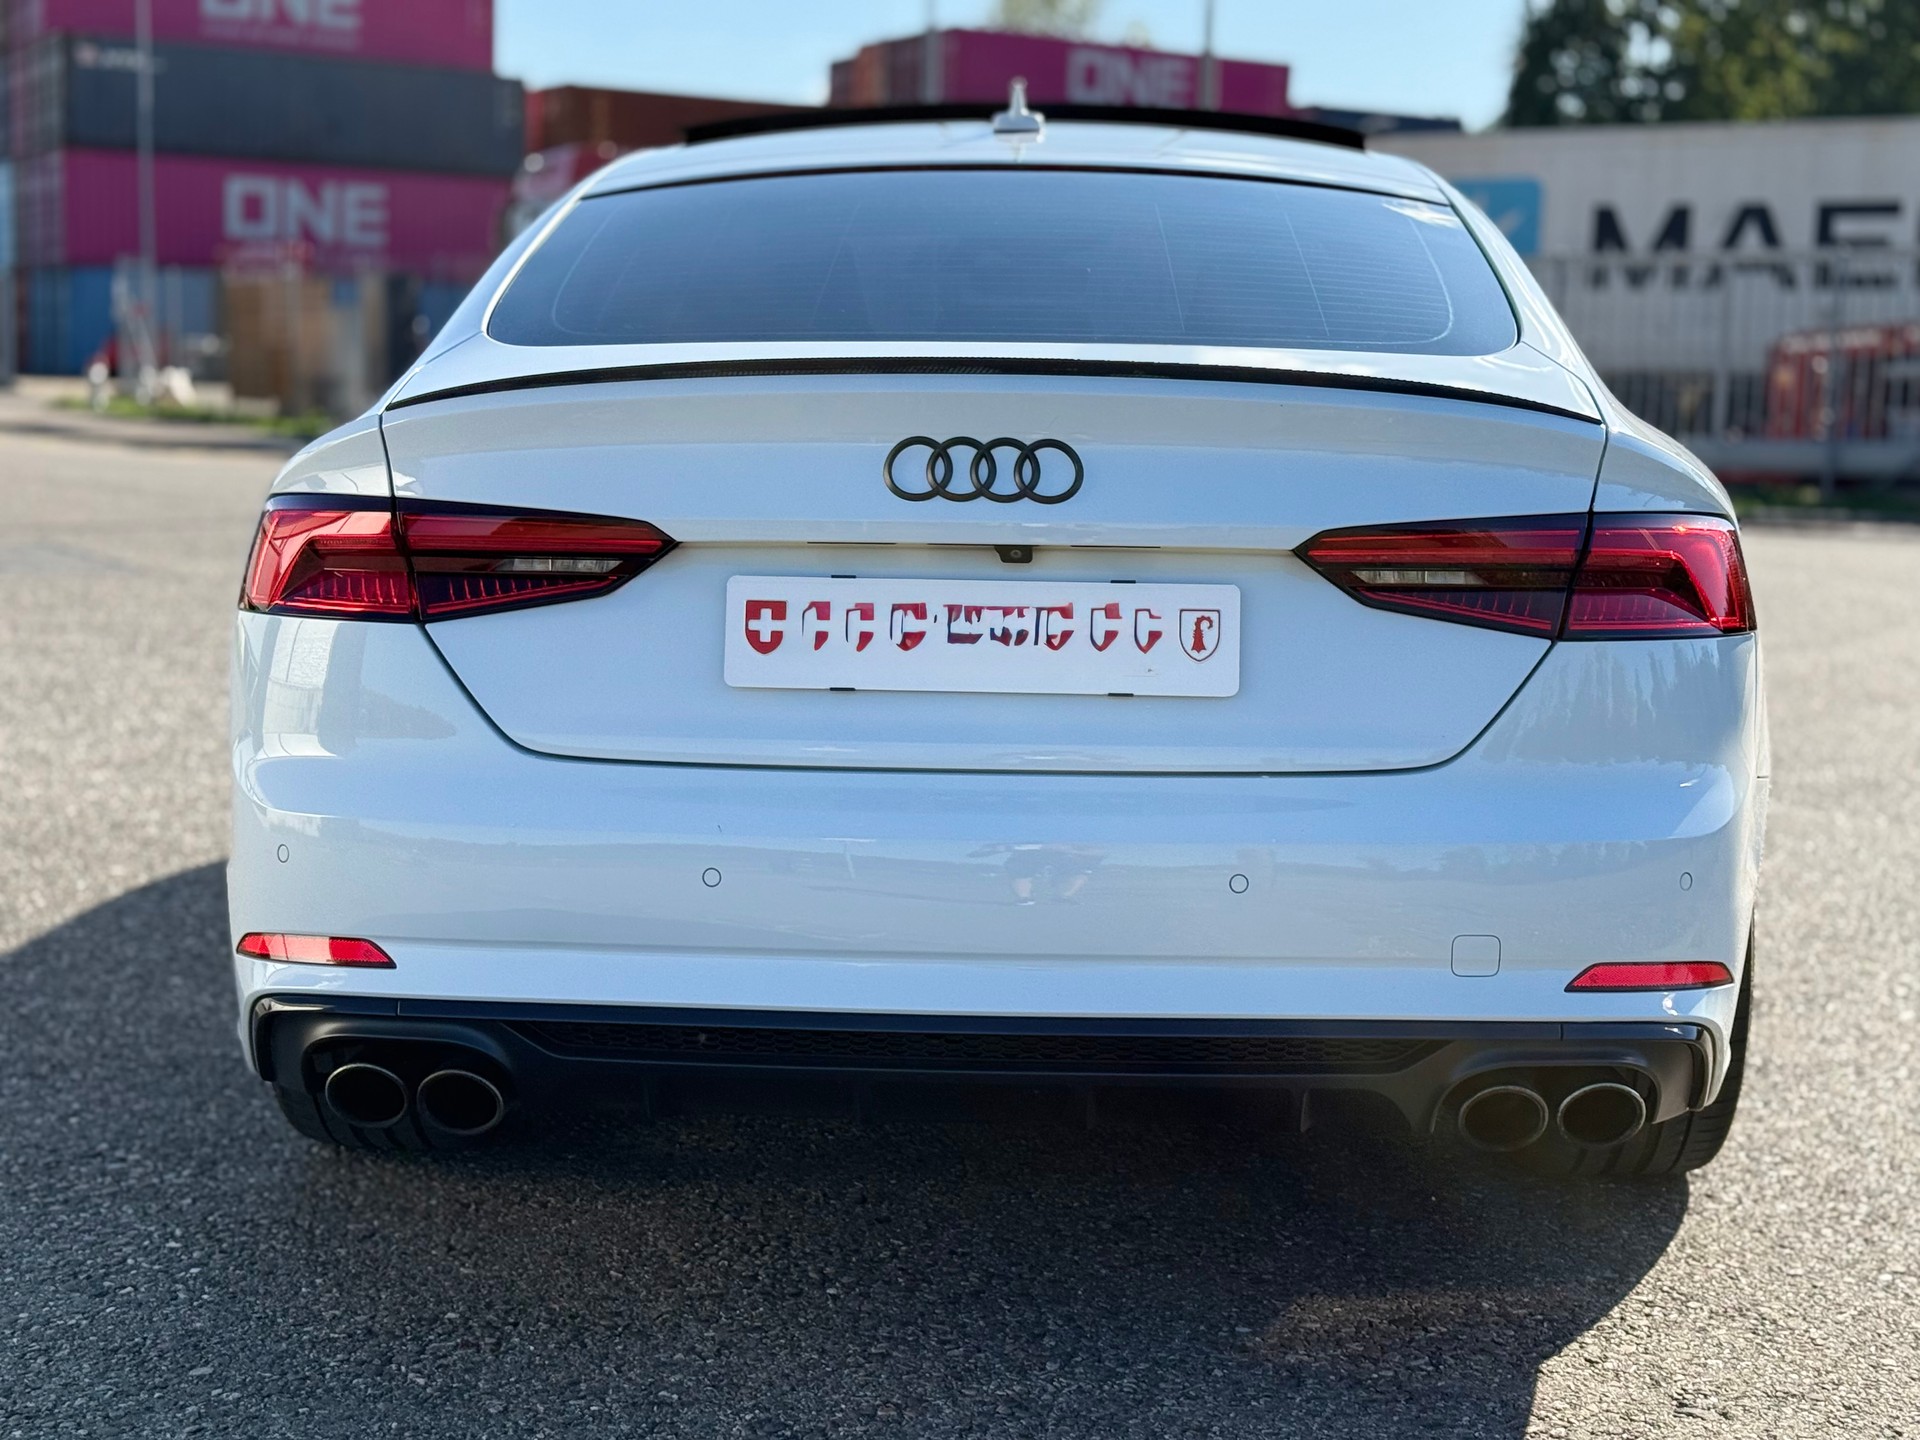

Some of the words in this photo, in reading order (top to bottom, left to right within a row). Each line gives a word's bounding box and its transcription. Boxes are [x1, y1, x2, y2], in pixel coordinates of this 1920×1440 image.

[1067, 51, 1188, 107] ONE
[225, 174, 388, 246] ONE
[1591, 199, 1920, 288] MAE
